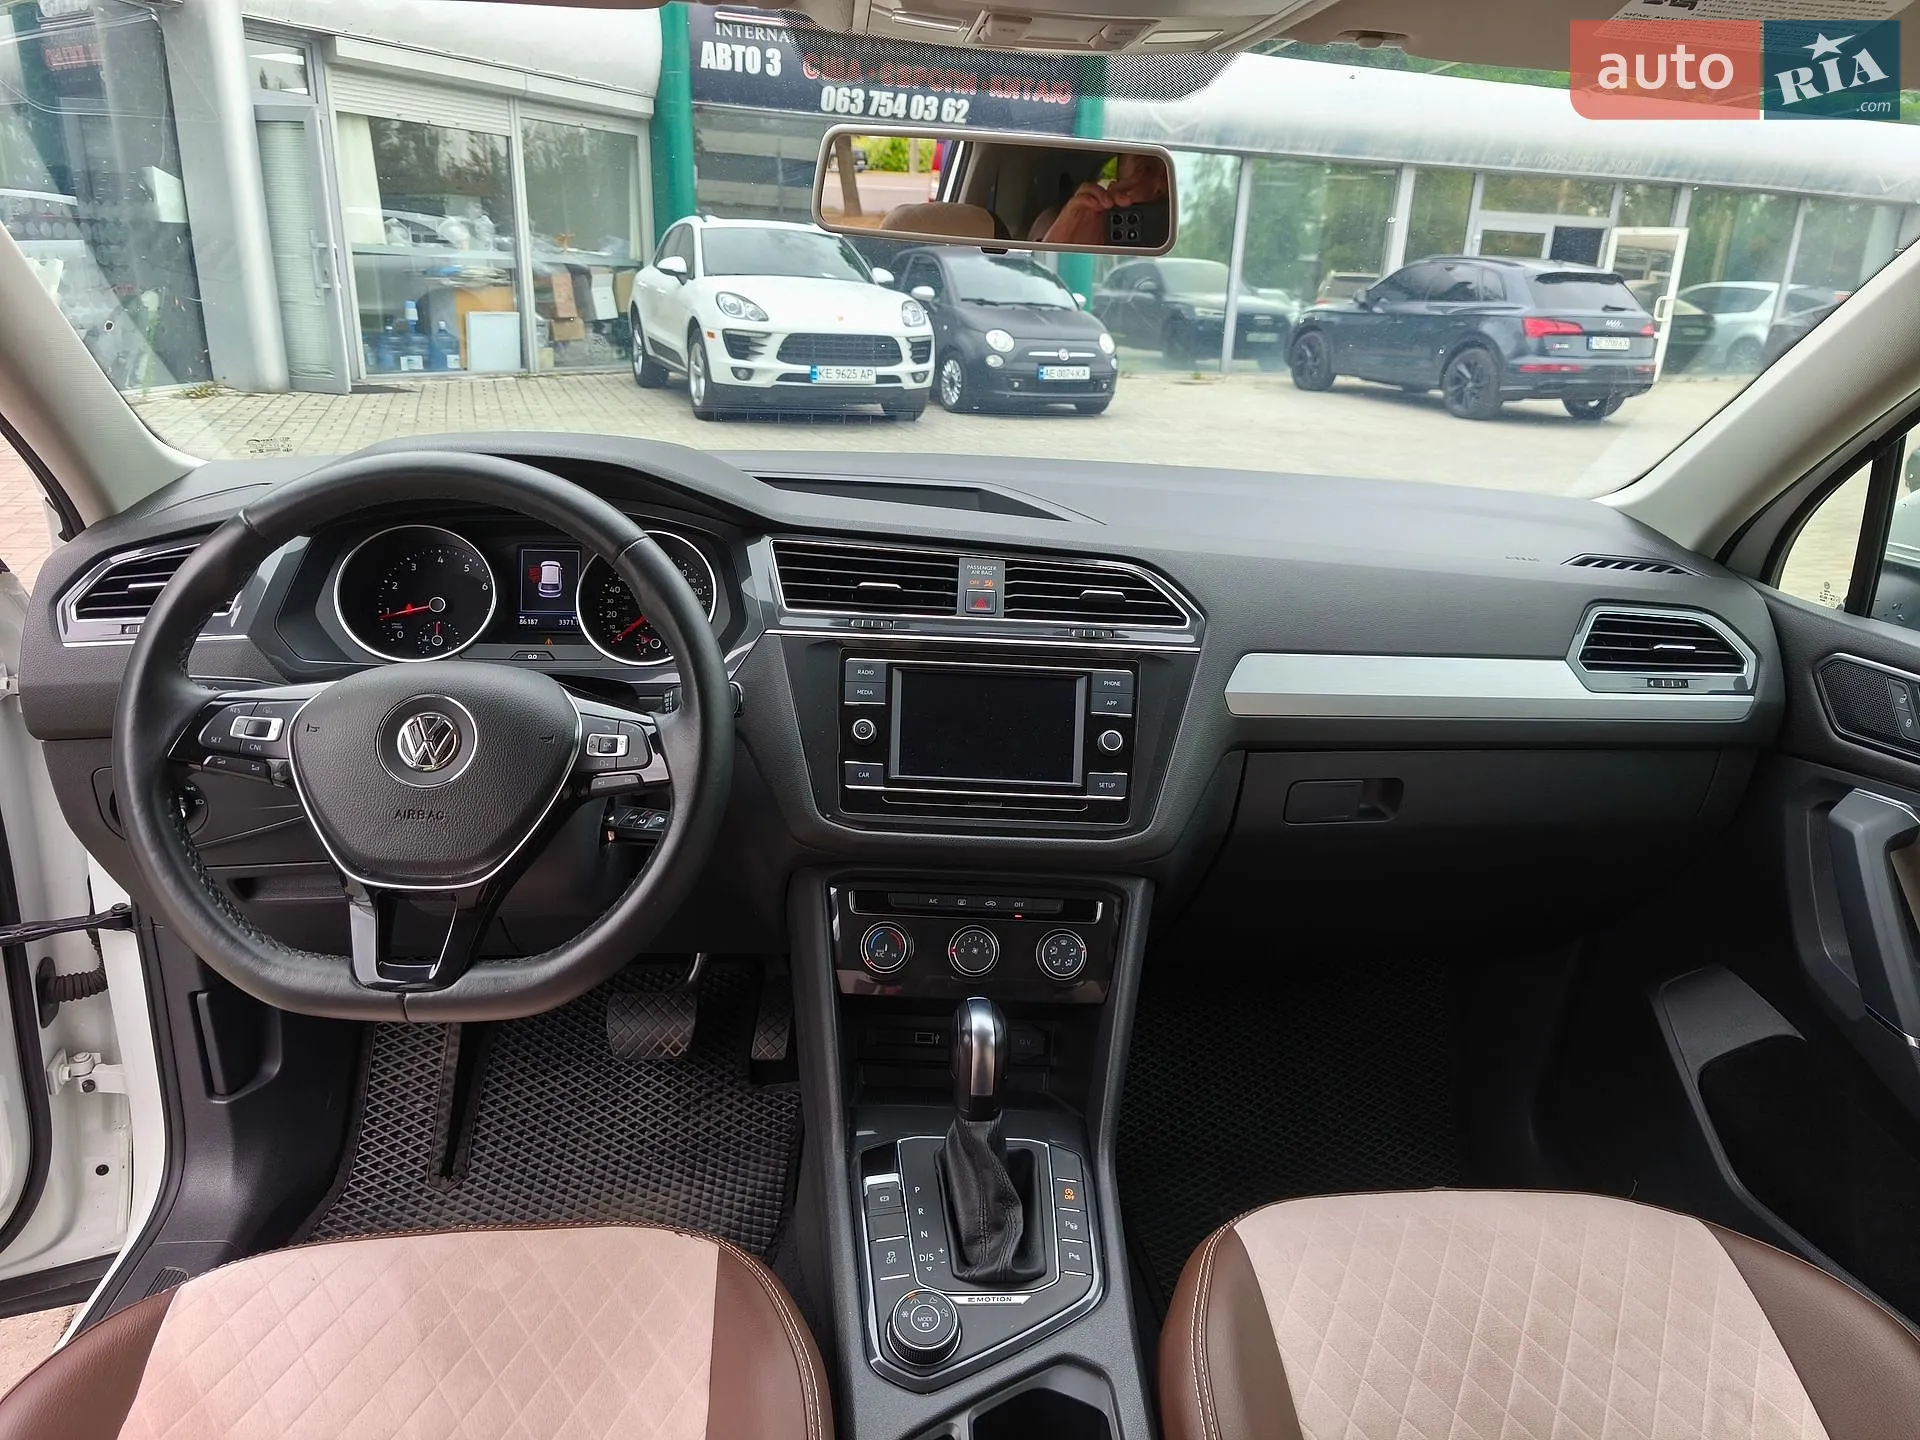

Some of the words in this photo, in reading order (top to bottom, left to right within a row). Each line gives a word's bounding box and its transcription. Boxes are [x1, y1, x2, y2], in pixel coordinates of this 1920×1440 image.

[700, 41, 761, 75] АВТО
[820, 86, 865, 114] 063
[868, 90, 908, 118] 754
[909, 95, 939, 122] 03
[941, 98, 970, 124] 62
[437, 556, 444, 564] 4
[410, 563, 417, 571] 3
[463, 564, 470, 572] 5
[391, 581, 398, 590] 2
[481, 582, 489, 591] 6
[609, 586, 621, 594] 40
[606, 610, 617, 618] 20
[396, 630, 404, 639] 0
[210, 736, 222, 744] SET
[249, 743, 262, 751] CNL
[394, 809, 444, 821] AIRBAG
[918, 1207, 925, 1216] R
[920, 1230, 928, 1238] N
[919, 1253, 935, 1262] D/S
